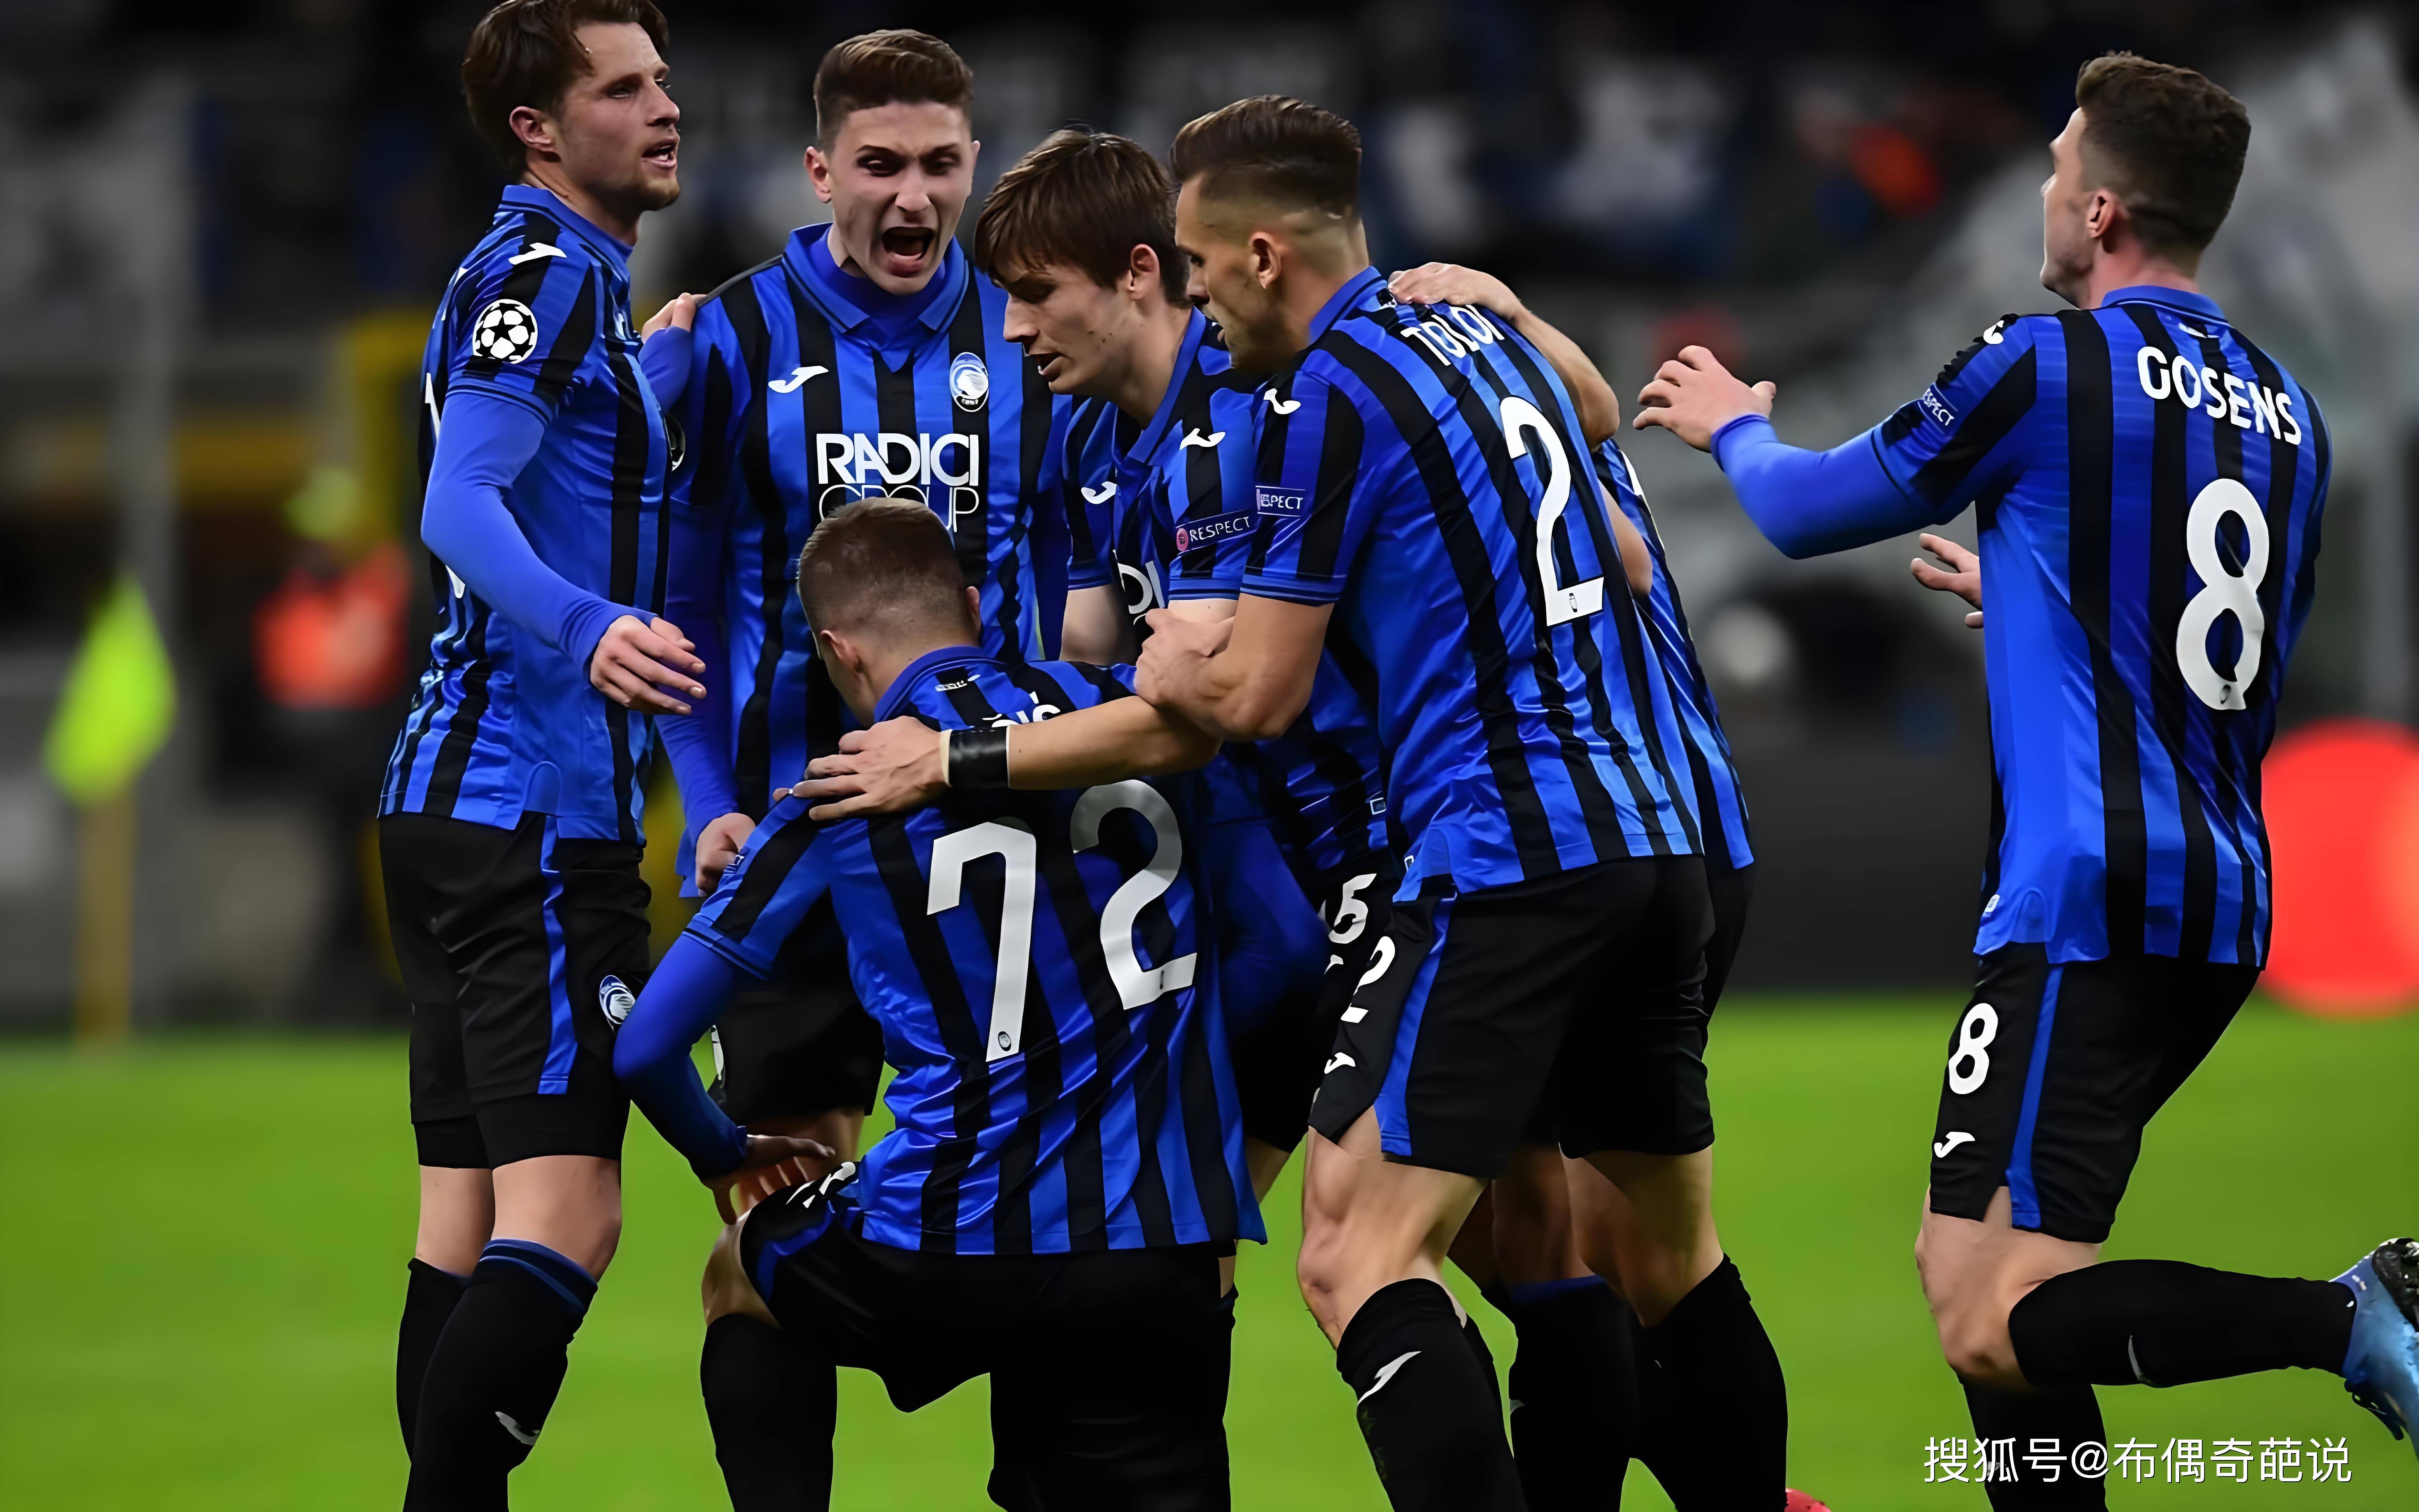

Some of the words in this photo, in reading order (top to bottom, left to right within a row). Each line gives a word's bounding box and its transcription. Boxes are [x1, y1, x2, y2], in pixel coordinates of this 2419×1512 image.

[1400, 304, 1505, 366] TOLOI
[2137, 346, 2302, 446] GOSENS
[816, 433, 979, 486] RADICI
[1189, 516, 1250, 541] RESPECT
[1500, 396, 1605, 627] 2
[2176, 478, 2270, 710] 8
[927, 779, 1197, 1062] 72
[1318, 873, 1376, 944] 5
[1948, 1003, 1998, 1095] 8
